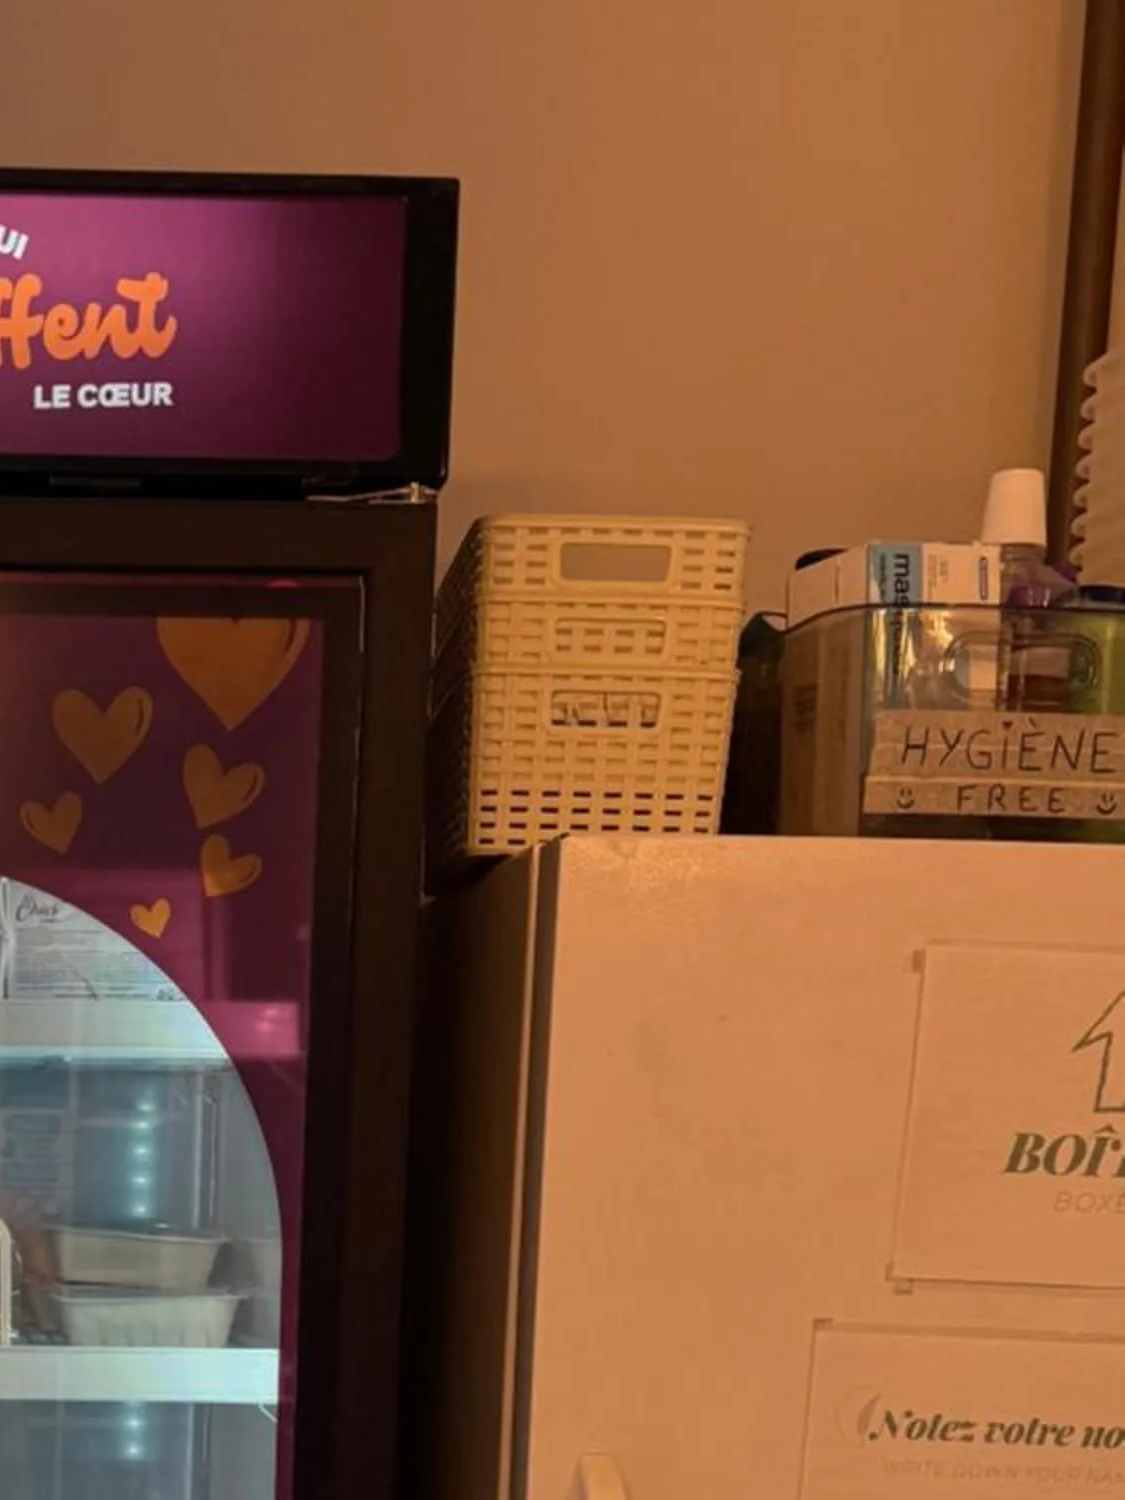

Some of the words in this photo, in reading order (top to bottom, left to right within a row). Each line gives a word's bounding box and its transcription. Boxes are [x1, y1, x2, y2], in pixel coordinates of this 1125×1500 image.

[33, 385, 71, 410] LE
[76, 383, 173, 409] CŒUR
[956, 783, 1065, 813] FREE
[869, 1410, 977, 1442] Notez
[984, 1418, 1075, 1446] votre
[1081, 1425, 1125, 1449] no
